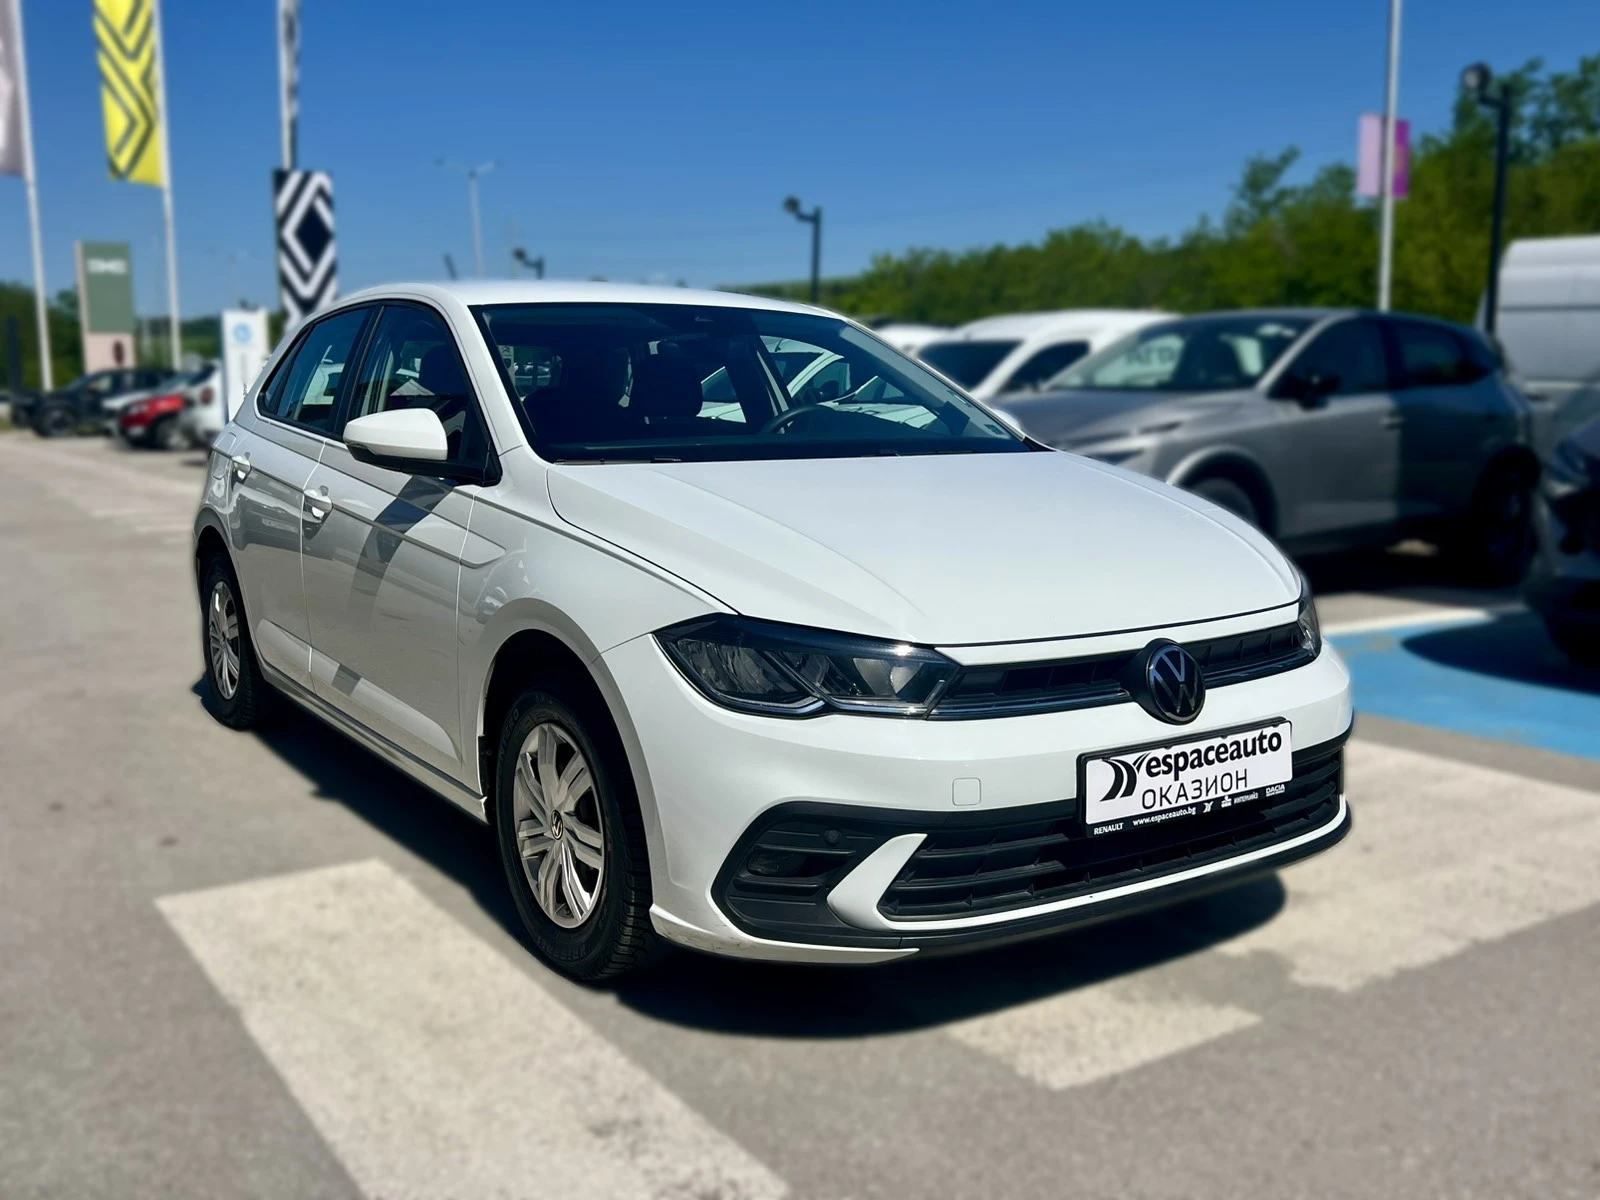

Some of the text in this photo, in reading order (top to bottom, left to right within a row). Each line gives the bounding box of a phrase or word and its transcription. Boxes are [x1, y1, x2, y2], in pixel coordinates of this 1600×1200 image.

[1145, 730, 1282, 781] espaceauto
[1141, 769, 1248, 809] ОКАЗИОН
[1265, 783, 1286, 794] DACIA
[1132, 806, 1197, 826] www.espaceauto.bg
[1093, 822, 1124, 836] RENAULT
